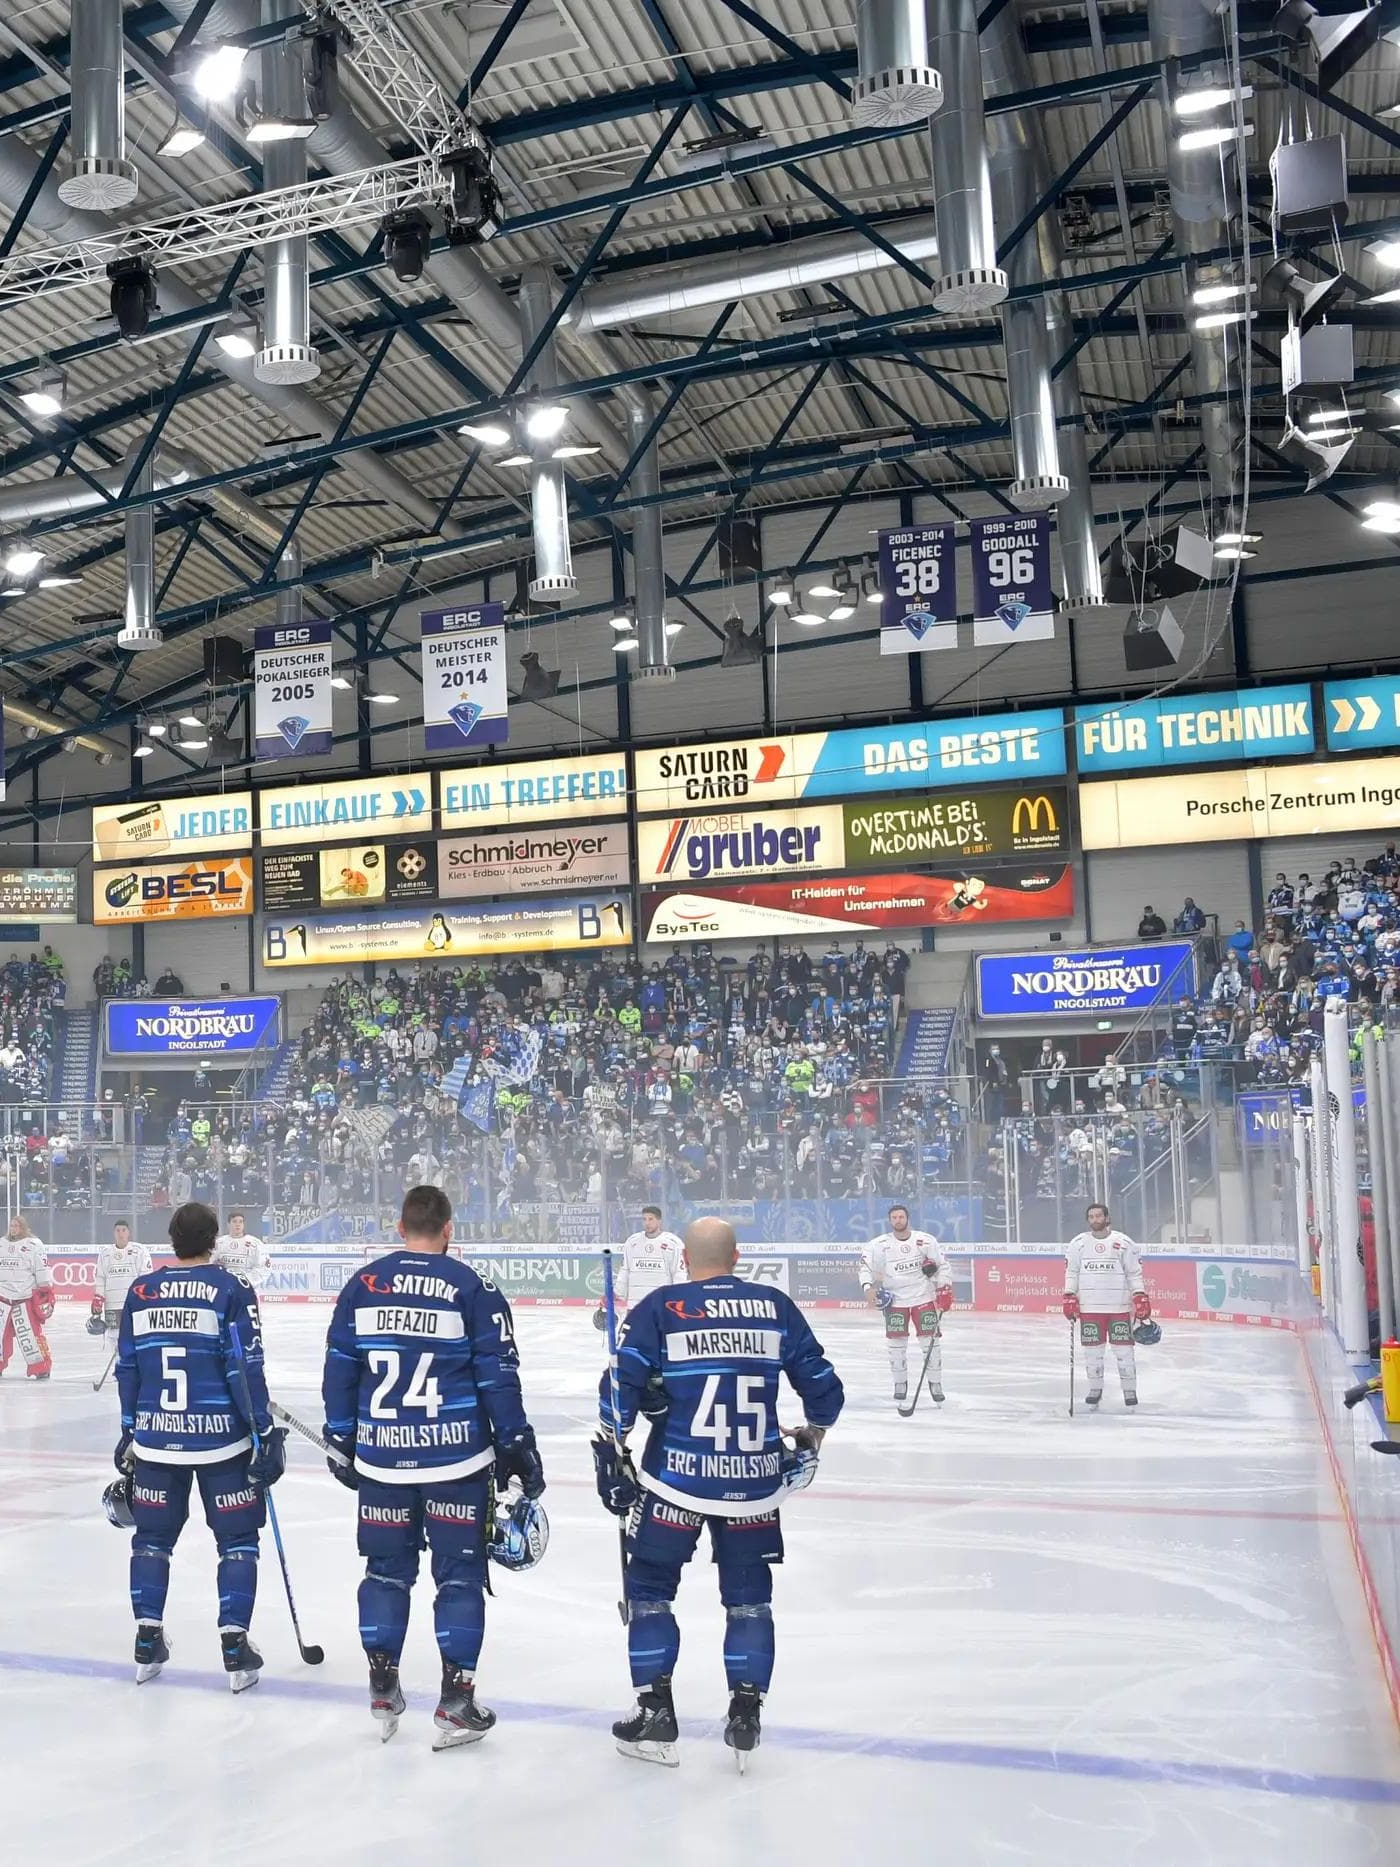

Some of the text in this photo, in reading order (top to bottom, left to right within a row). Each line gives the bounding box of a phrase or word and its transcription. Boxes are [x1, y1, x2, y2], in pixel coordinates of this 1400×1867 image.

[889, 530, 945, 545] 2003 2014
[983, 519, 1037, 535] 1999 2010
[892, 545, 942, 562] FICENEC
[982, 534, 1039, 552] GOODALL
[896, 559, 940, 597] 38
[988, 549, 1035, 587] 96
[429, 636, 498, 654] DEUTSCHER
[261, 652, 325, 670] DEUTSCHER
[436, 651, 492, 669] MEISTER
[256, 666, 330, 684] POKALSIEGER
[441, 668, 489, 689] 2014
[271, 684, 315, 703] 2005
[1083, 701, 1311, 756] FÜR TECHNIK
[659, 745, 748, 779] SATURN
[863, 727, 1040, 776] DAS BESTE
[445, 767, 626, 815] EIN TREFFER!
[685, 773, 749, 801] CARD
[269, 793, 381, 830] EINKAUF
[1186, 788, 1356, 817] Porsche Zentrum
[173, 807, 248, 841] JEDER
[689, 815, 750, 835] MÖBEL
[449, 836, 608, 865] schmidmeyer
[686, 822, 822, 878] gruber
[472, 864, 553, 879] Erdbau Abbruch
[142, 870, 243, 901] BESL
[791, 885, 866, 900] IT-Helden für
[522, 908, 573, 921] Development
[844, 897, 926, 912] Unternehmen
[656, 921, 720, 936] SysTec
[1011, 964, 1160, 996] NORDBRÄU
[1053, 995, 1127, 1009] INGOLSTADT
[135, 1014, 256, 1039] NORDBRÄU
[168, 1039, 227, 1050] INGOLSTADT
[159, 1281, 219, 1303] SATURN
[392, 1273, 460, 1304] SATURN
[148, 1309, 198, 1331] WAGNER
[704, 1299, 778, 1321] SATURN
[11, 1305, 38, 1357] medical
[376, 1309, 438, 1335] DEFAZIO
[685, 1331, 767, 1356] MARSHALL
[159, 1346, 188, 1412] 5
[367, 1350, 444, 1420] 24
[151, 1412, 231, 1434] INGOLSTADT
[689, 1374, 767, 1453] 45
[376, 1420, 472, 1449] INGOLSTADT
[666, 1450, 783, 1480] ERC INGOLSTADT
[360, 1504, 411, 1523] CINQUE
[425, 1500, 477, 1521] CINQUE
